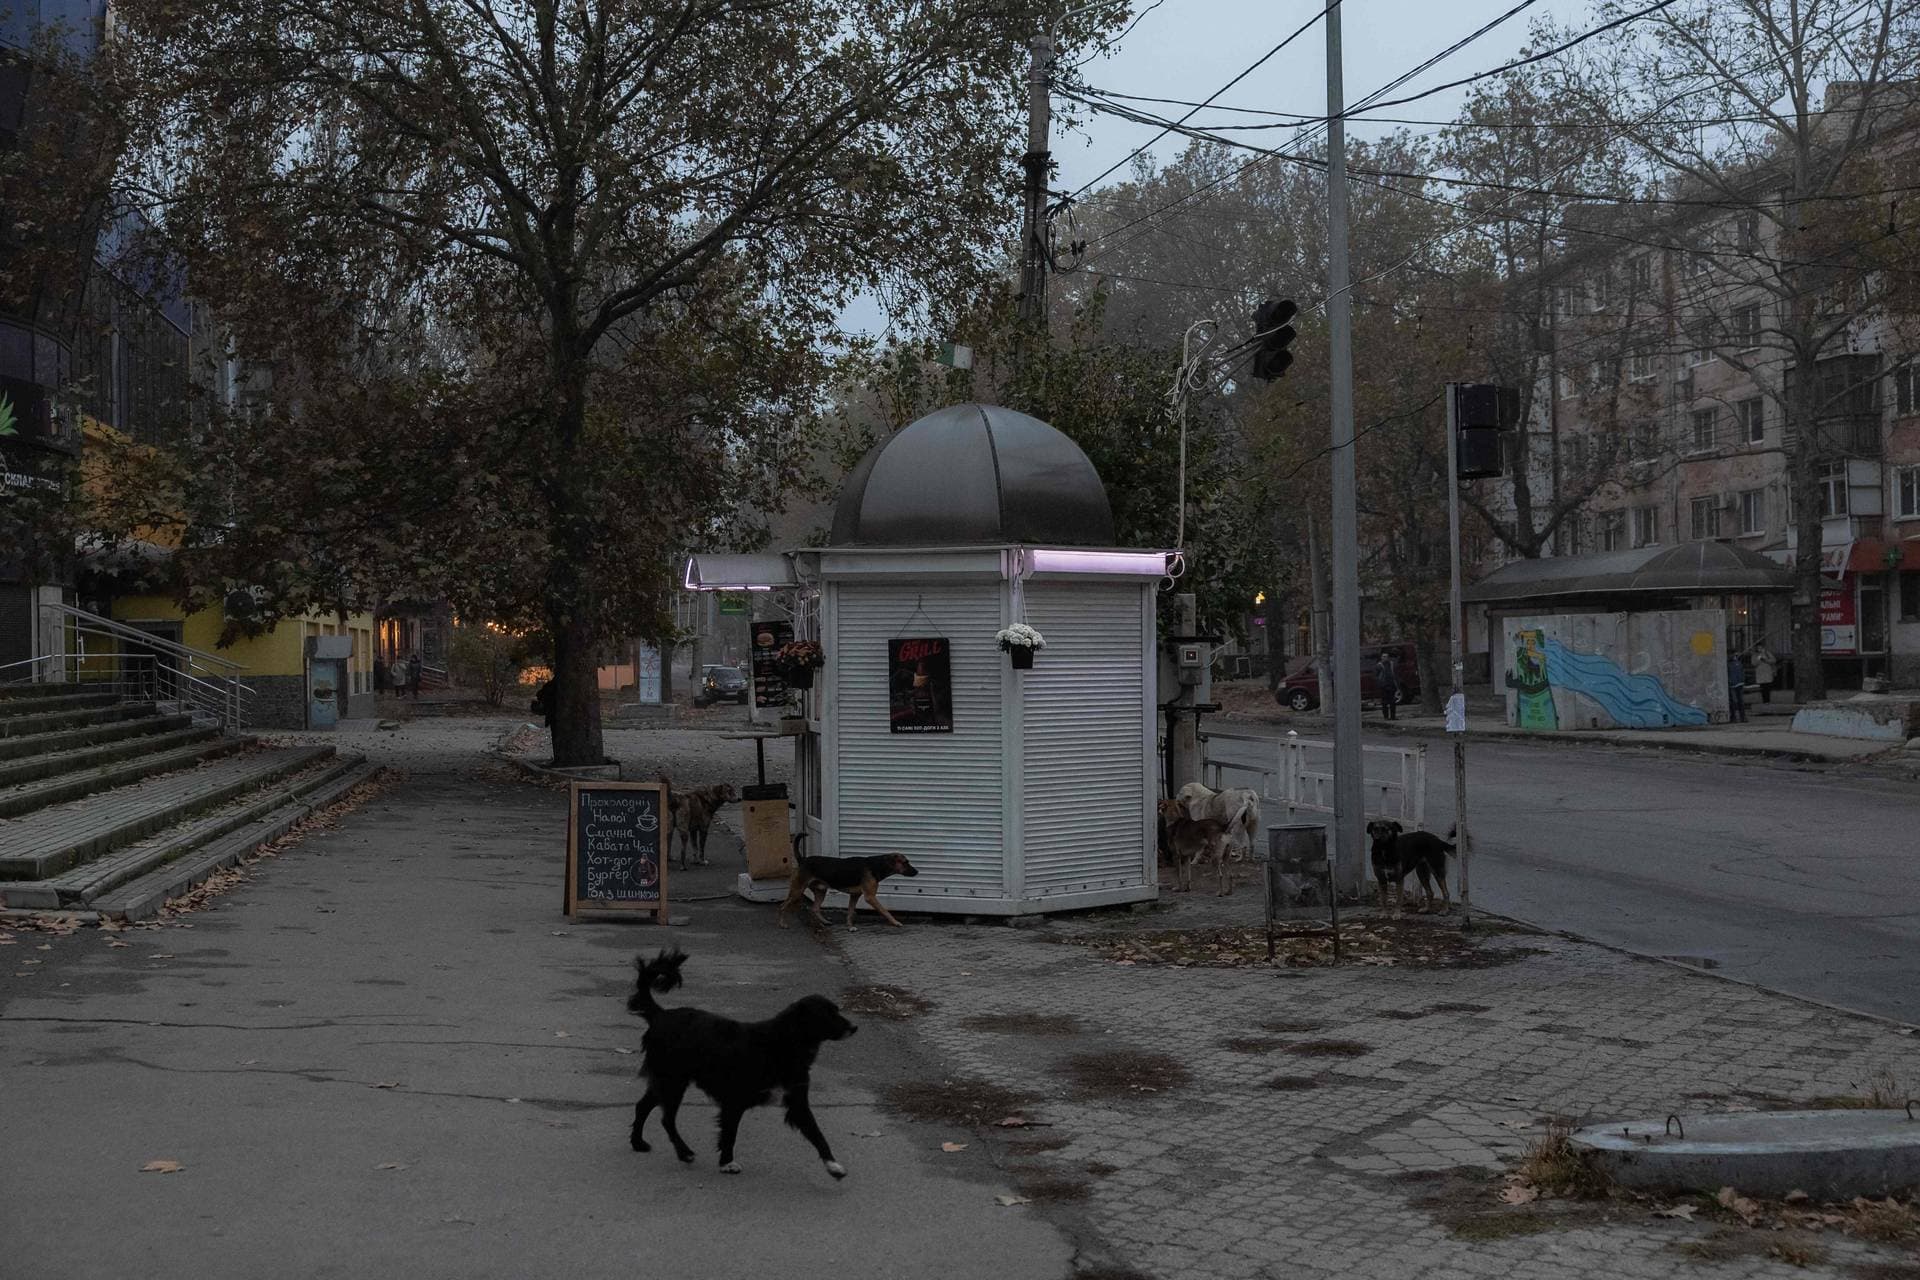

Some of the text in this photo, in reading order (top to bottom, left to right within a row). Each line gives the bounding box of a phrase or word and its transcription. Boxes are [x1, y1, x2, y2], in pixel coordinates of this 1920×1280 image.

[582, 793, 645, 813] Прохолодні
[593, 808, 626, 823] Напої
[586, 823, 635, 839] Смачна
[587, 851, 633, 871] Хот-дог
[588, 867, 630, 885] Бургер
